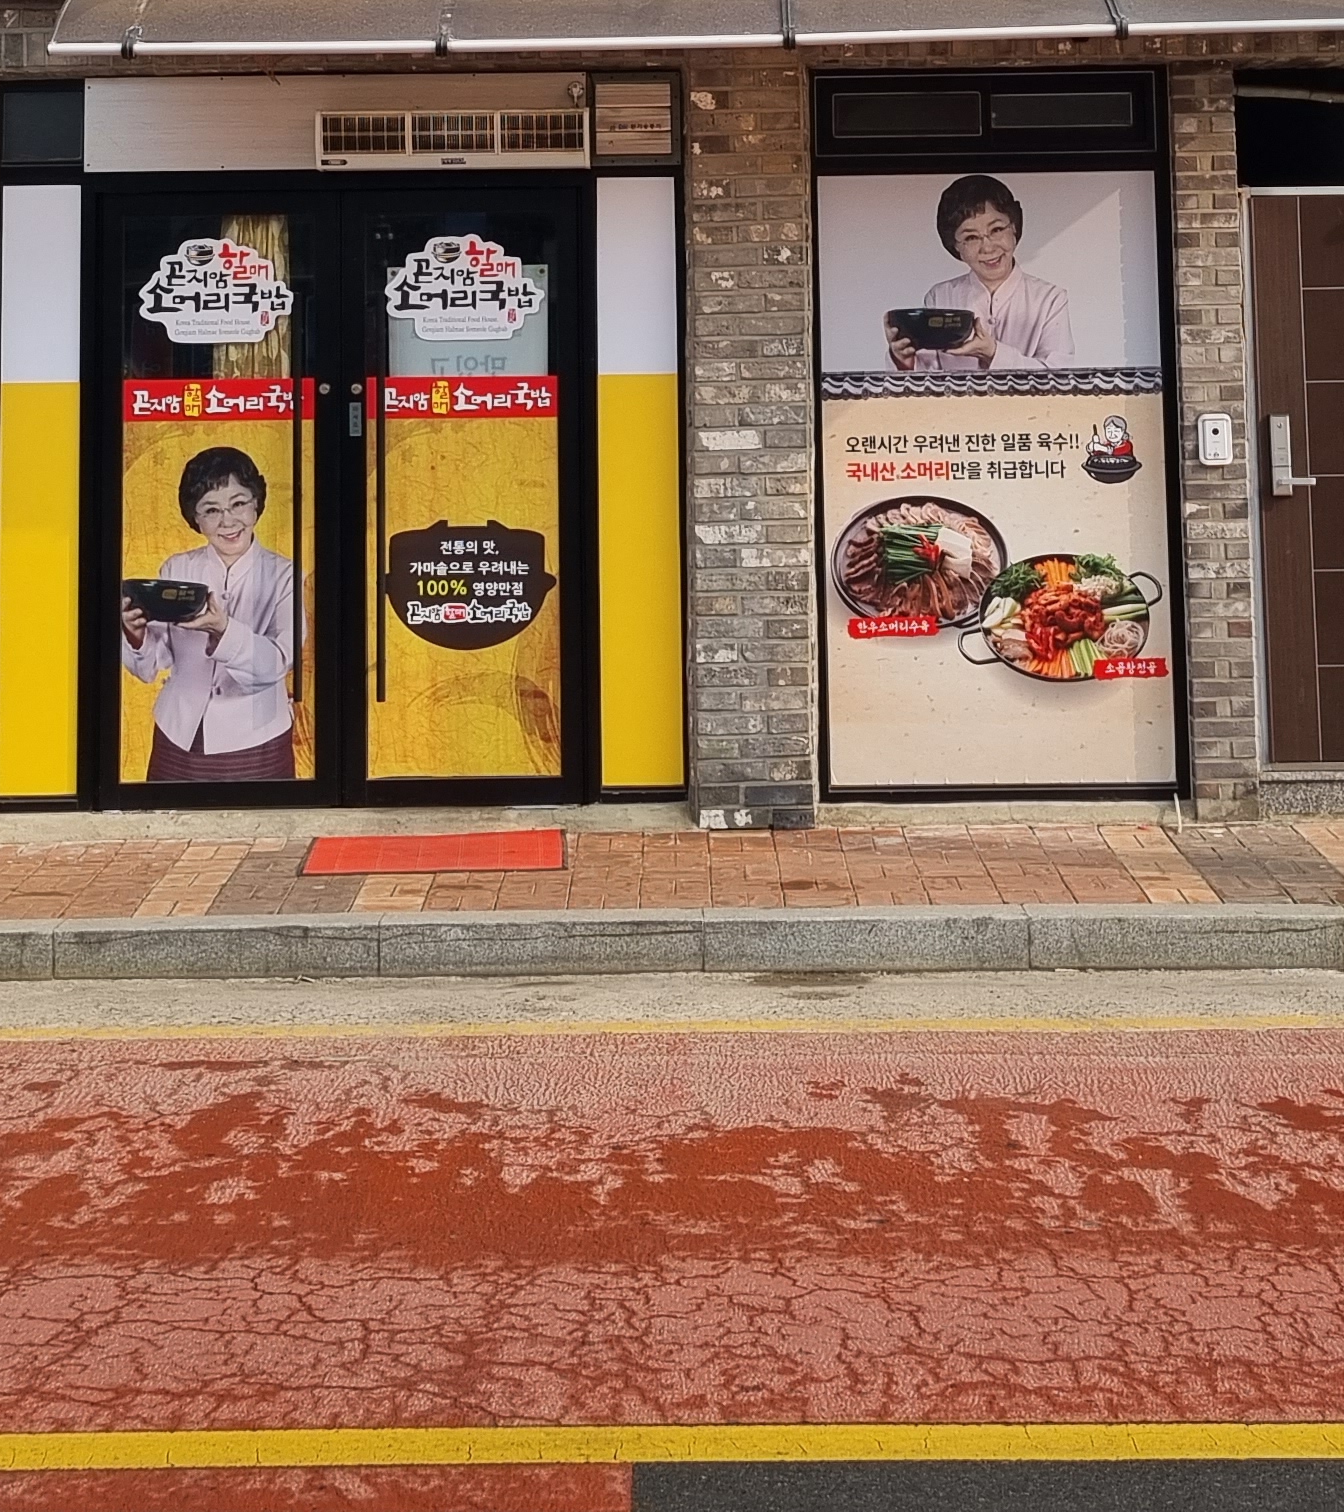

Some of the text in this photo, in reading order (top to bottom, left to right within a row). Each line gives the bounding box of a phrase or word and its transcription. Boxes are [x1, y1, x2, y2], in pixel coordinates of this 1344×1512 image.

[218, 242, 269, 281] 할매
[412, 257, 479, 287] 곤지암
[465, 240, 516, 279] 할매
[165, 260, 232, 290] 곤지암
[146, 276, 290, 314] 소머리국밥
[393, 274, 537, 312] 소머리국밥
[132, 390, 183, 416] 곤지암
[184, 384, 202, 417] 할매
[384, 381, 553, 414] 곤지암 할매 소머리국밥
[845, 432, 1080, 455] 오랜시간 우려낸 진한 일품 육수!!
[845, 460, 1067, 481] 국내산 소머리만을 취급합니다
[439, 540, 479, 555] 전통의
[409, 560, 530, 576] 가마솥으로 우려내는
[416, 579, 524, 597] 100% 영양만점
[407, 601, 442, 624] 곤지암
[467, 599, 532, 624] 소머리국밥
